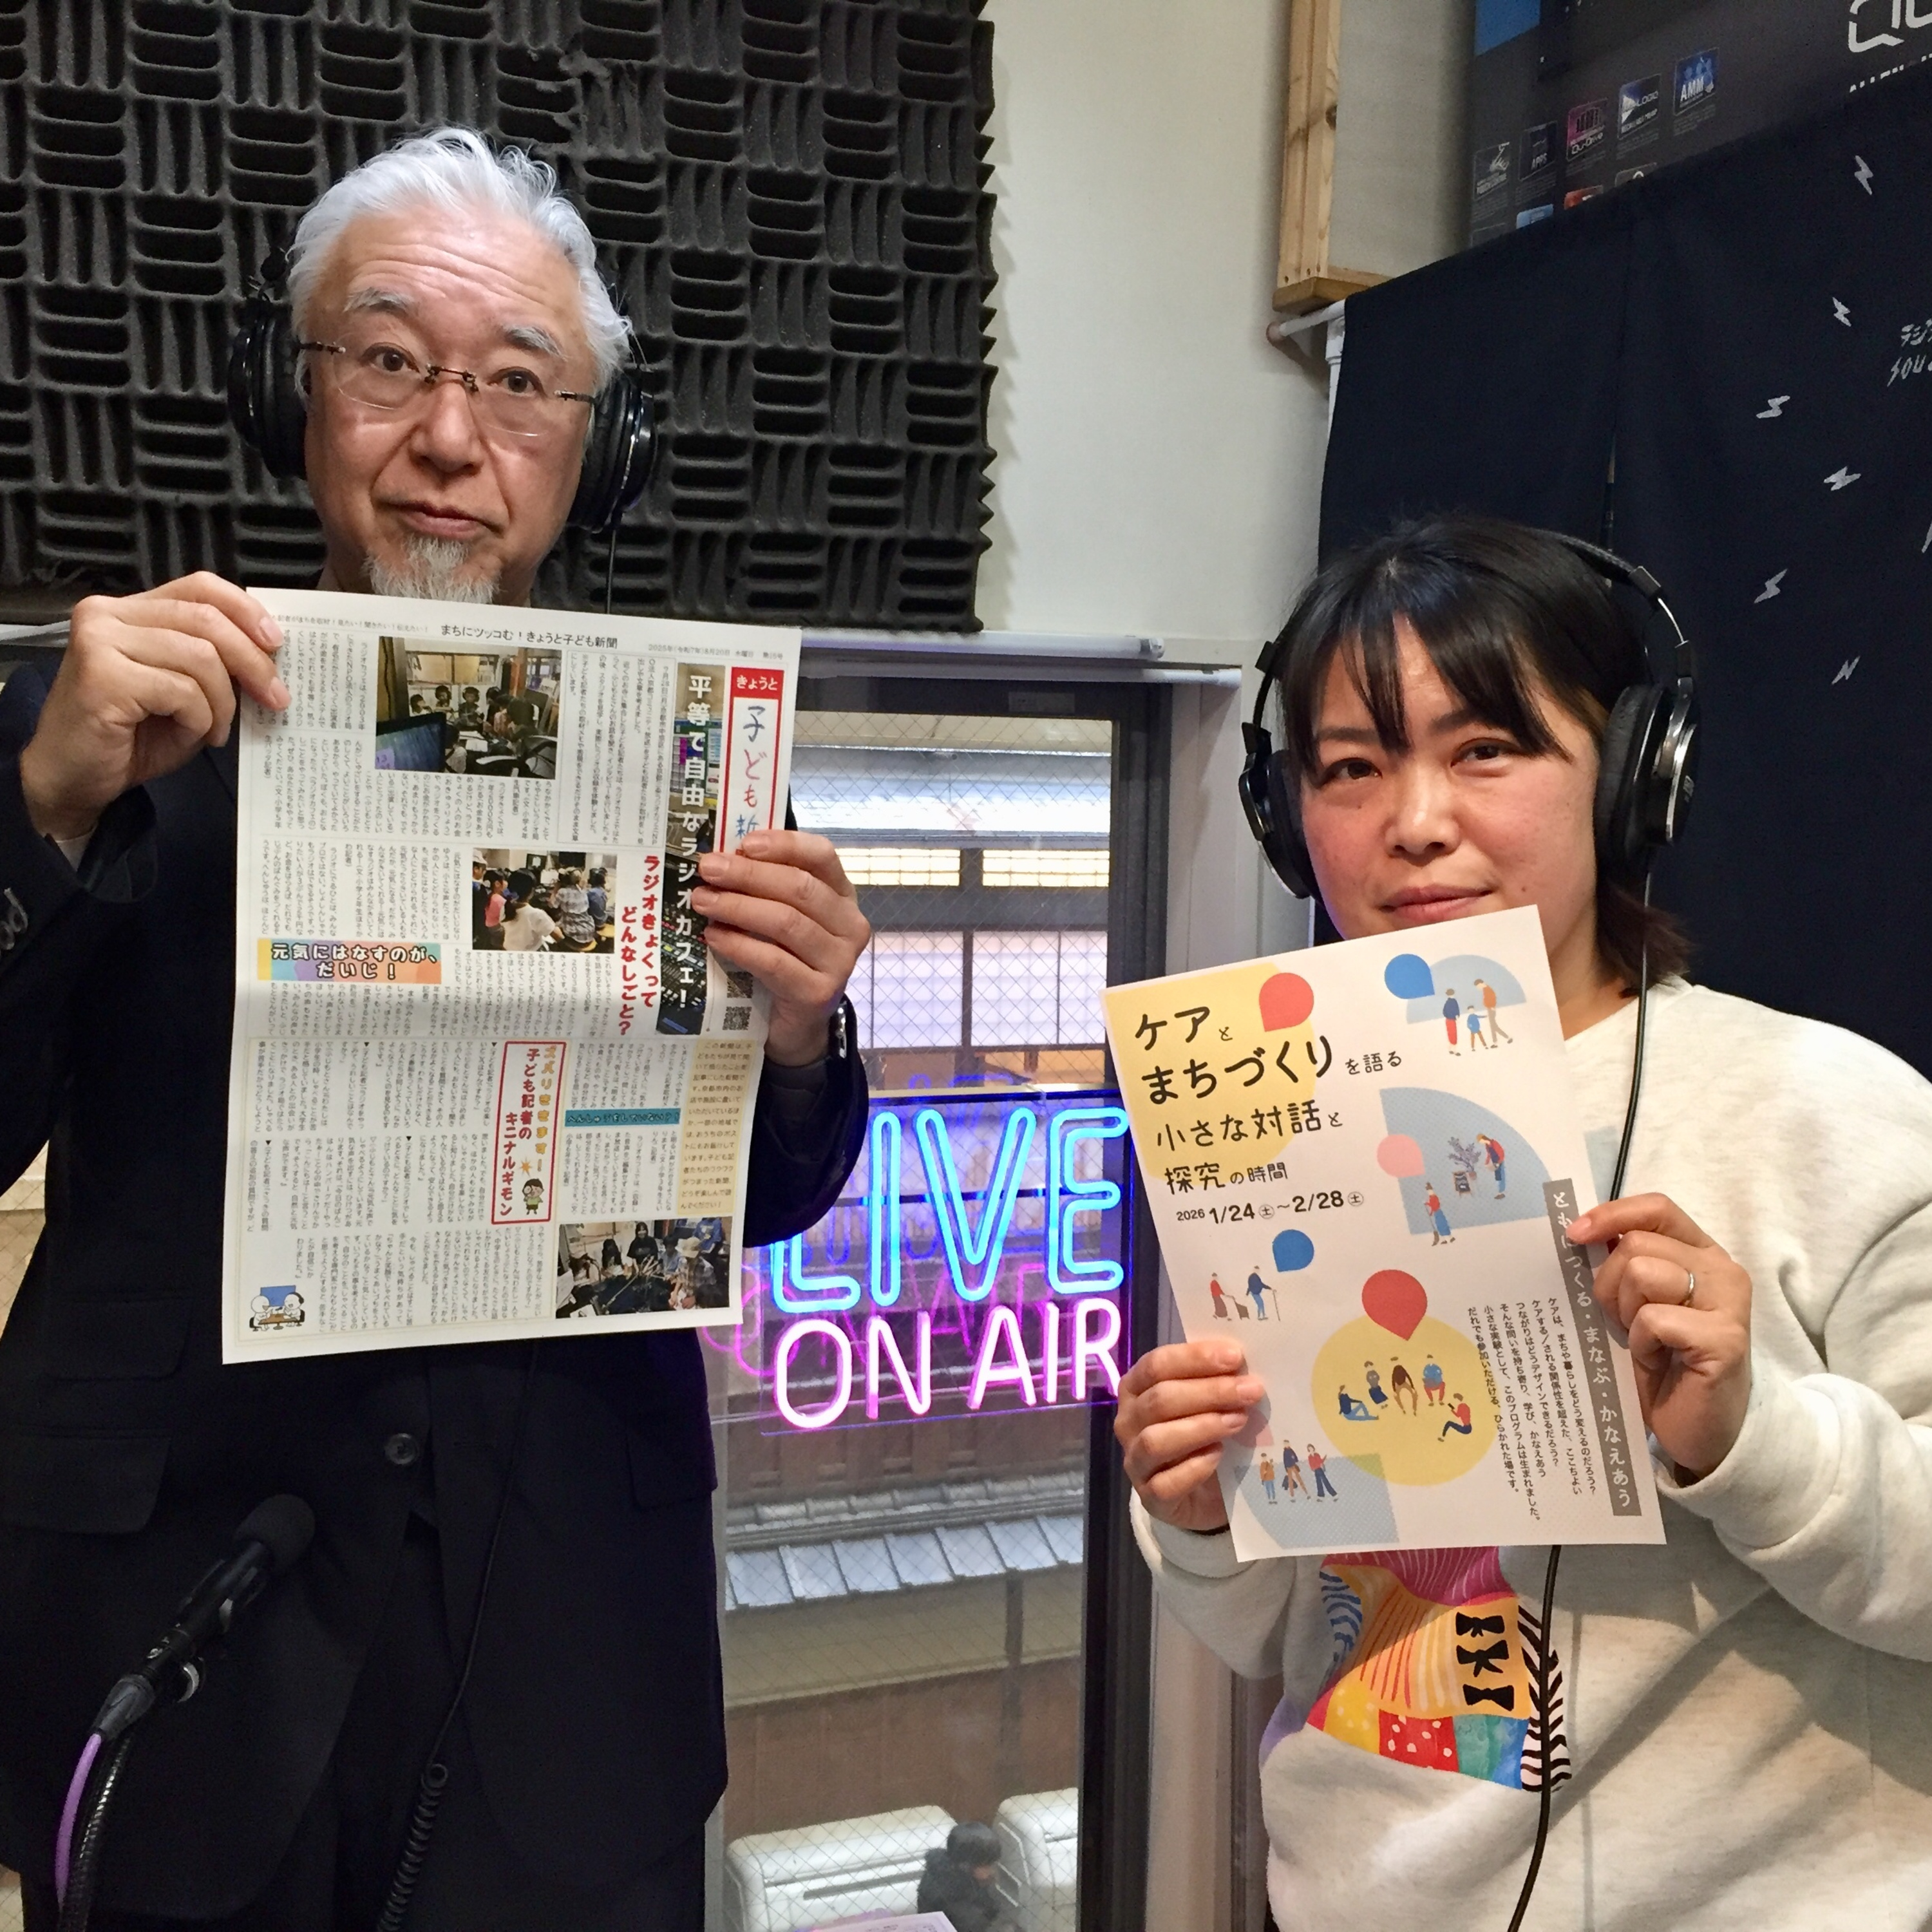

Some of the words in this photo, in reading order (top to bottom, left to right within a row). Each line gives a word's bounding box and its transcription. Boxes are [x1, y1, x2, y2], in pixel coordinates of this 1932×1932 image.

[440, 624, 618, 649] まちにツッコむ！きょうと子ども新聞
[736, 674, 778, 692] きょうと
[735, 705, 768, 838] 子ども新
[271, 942, 438, 964] 元気にはなすのが、
[316, 961, 396, 980] だいじ！
[641, 855, 661, 1008] ラジオきょくって
[1134, 1005, 1234, 1051] ケアと
[1141, 1035, 1403, 1105] まちづくりを語る
[518, 1048, 540, 1140] 子ども記者の
[1156, 1099, 1344, 1151] 小さな対話と
[500, 1112, 518, 1216] キニナルギモン
[771, 1106, 1129, 1313] LIVE
[1164, 1161, 1289, 1195] 探究の時間
[1176, 1208, 1206, 1222] 2026
[774, 1310, 932, 1428] ON
[967, 1297, 1124, 1410] AIR
[1468, 1306, 1519, 1493] だれでも参加いただける、ひらかれた場です。
[1499, 1302, 1547, 1479] そんな問いを持ち寄り、学び、かなえあう
[1515, 1300, 1559, 1467] つながりはどうデザインできるだろう？
[1548, 1296, 1597, 1495] ケアは、まちや暮らしをどう変えるのだろう？
[1483, 1305, 1540, 1521] 小さな実験として、このプログラムは生まれました。
